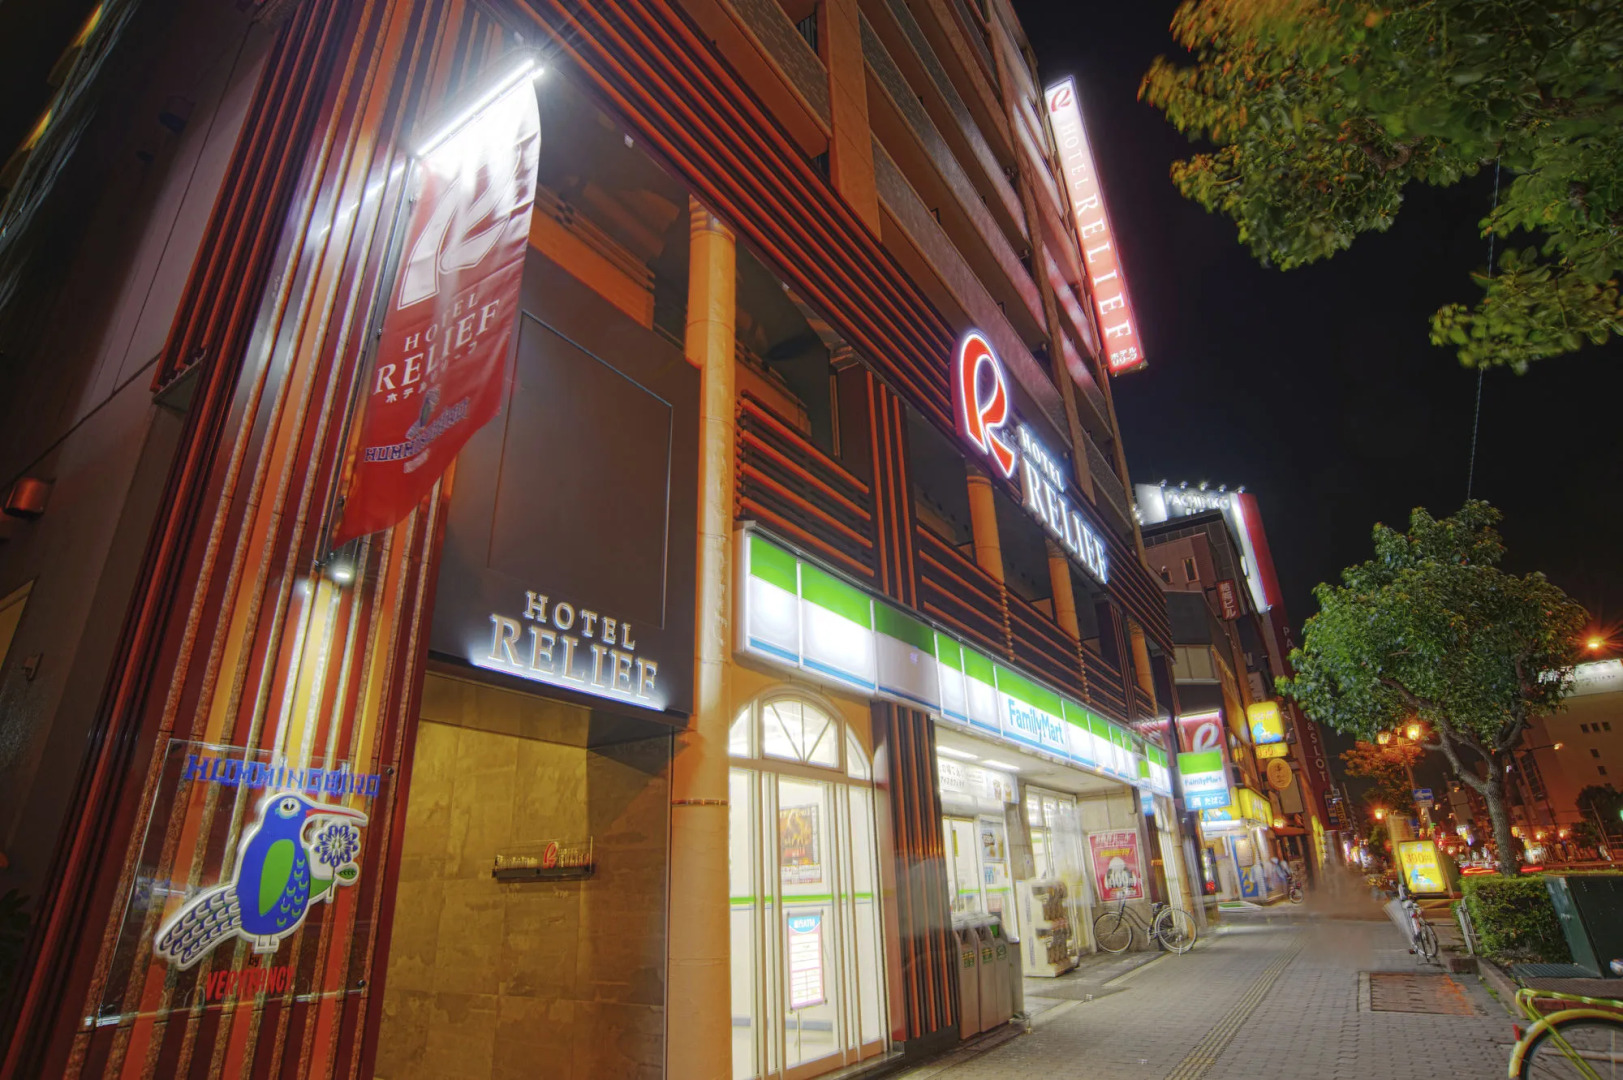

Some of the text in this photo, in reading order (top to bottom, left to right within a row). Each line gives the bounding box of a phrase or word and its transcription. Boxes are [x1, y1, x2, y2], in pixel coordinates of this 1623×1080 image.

[1062, 122, 1132, 338] HOTEL RELIEF
[373, 299, 500, 395] RELIEF
[1017, 424, 1065, 493] HOTEL
[1022, 456, 1108, 585] RELIEF
[487, 613, 659, 700] RELIEF
[524, 590, 636, 651] HOTEL
[1008, 698, 1064, 744] FamilyMart
[1184, 775, 1223, 787] FamilyMart
